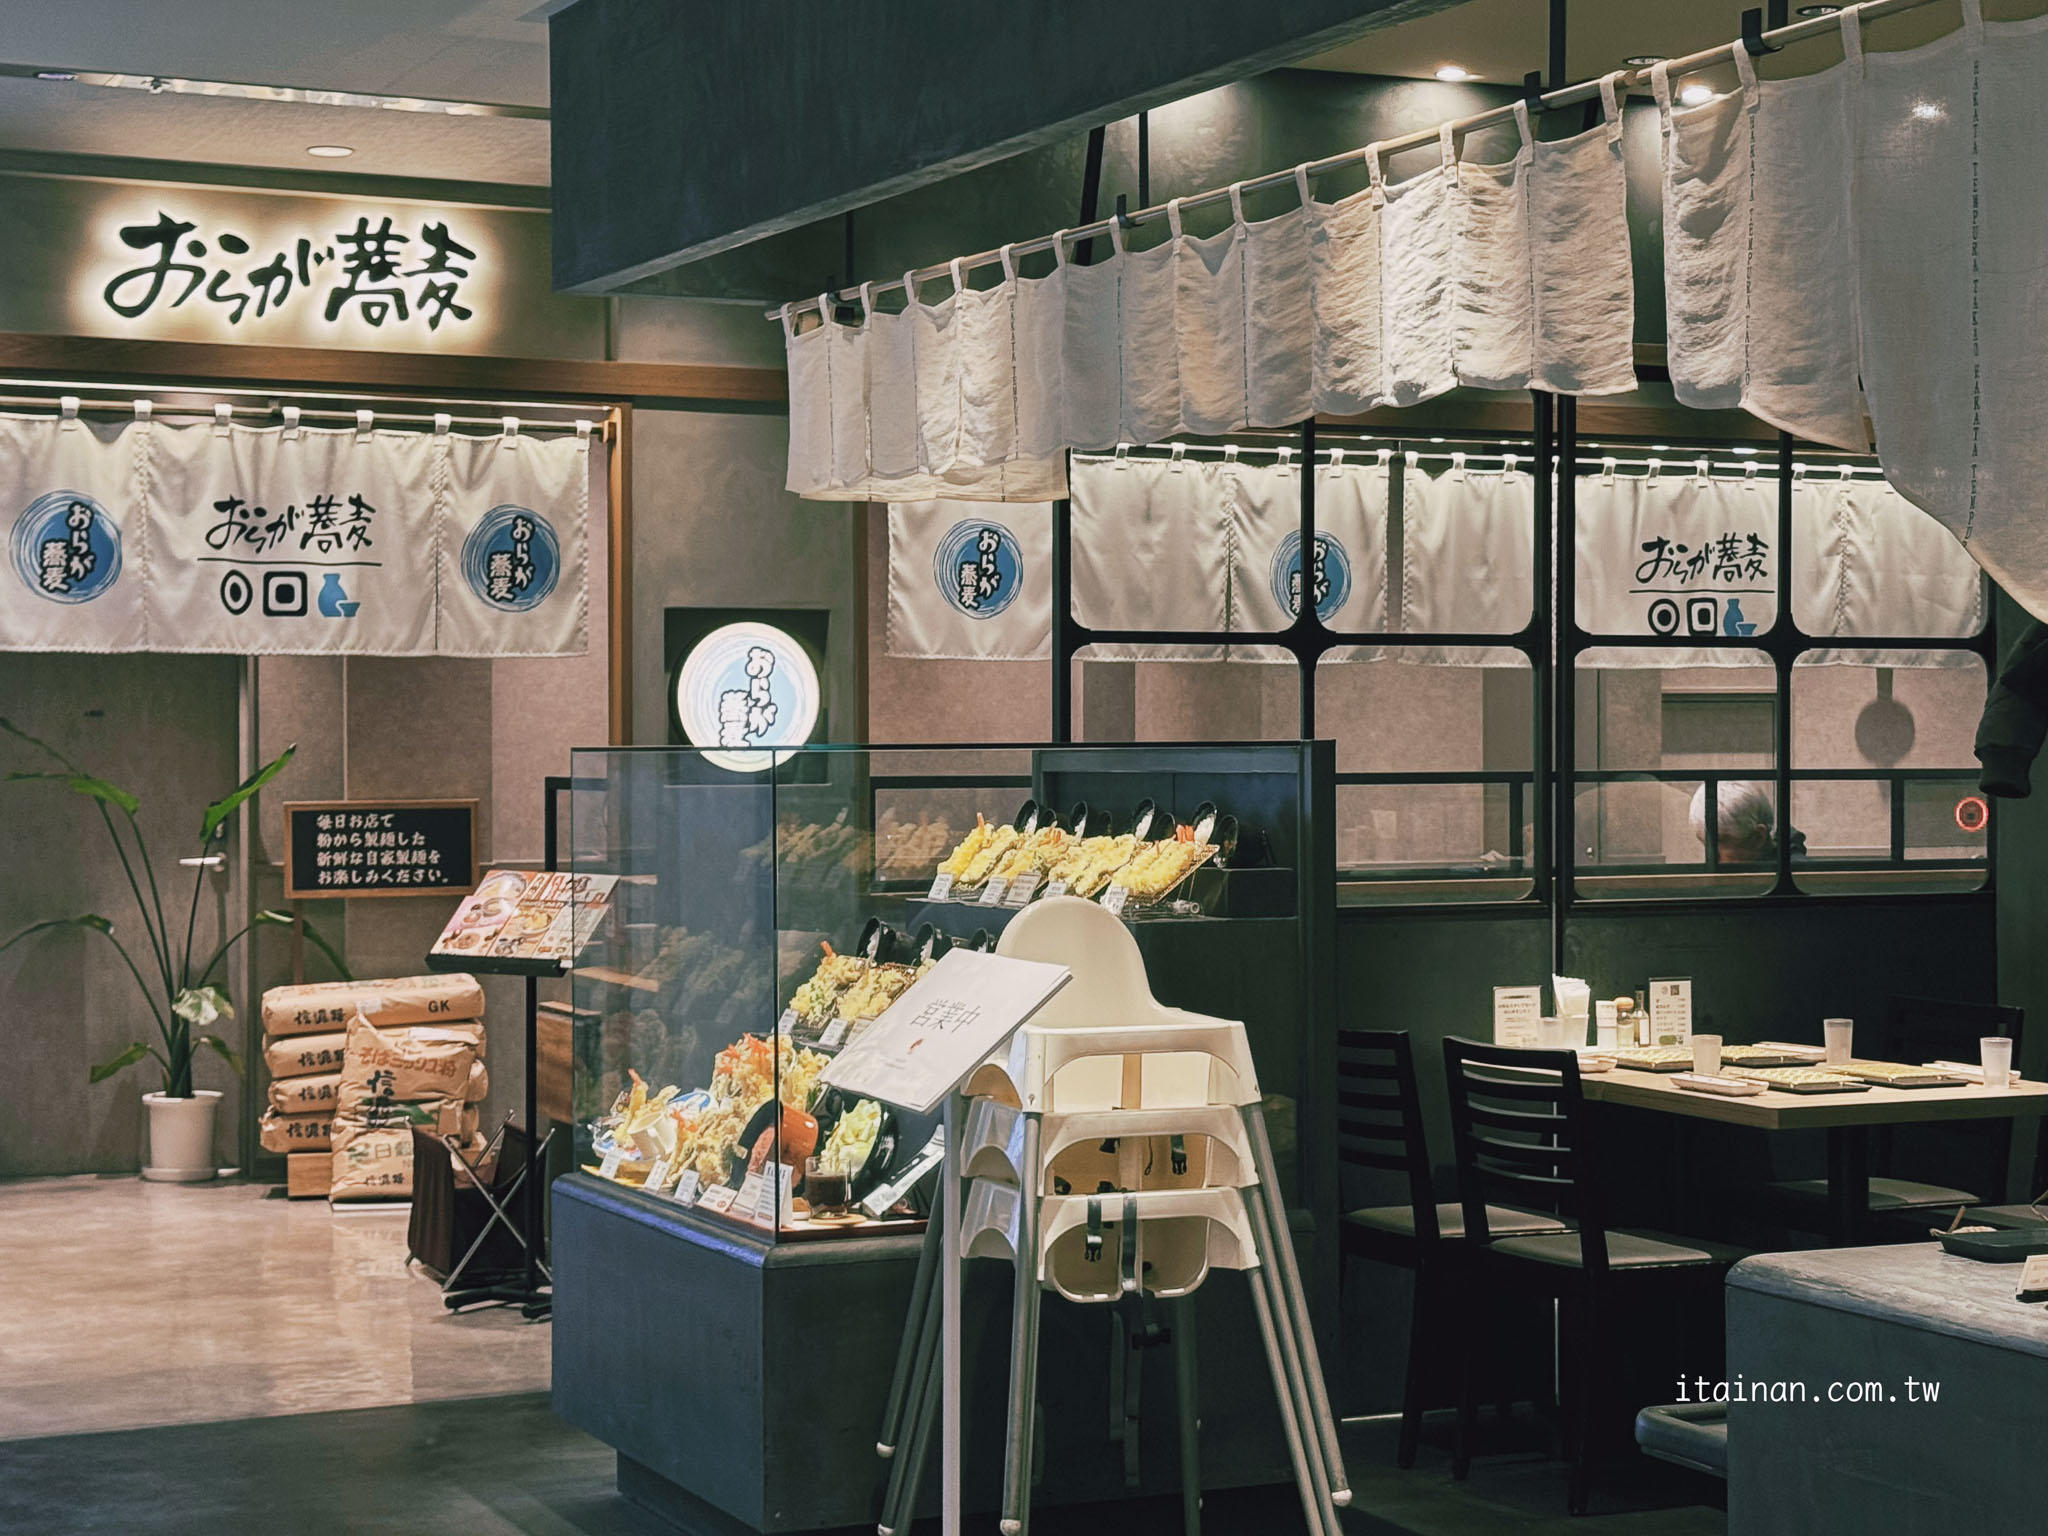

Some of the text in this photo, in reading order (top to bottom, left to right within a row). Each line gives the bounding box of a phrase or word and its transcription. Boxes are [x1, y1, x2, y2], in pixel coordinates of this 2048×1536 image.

[104, 211, 477, 331] おらが蕎麦
[65, 501, 96, 581] おらが
[206, 494, 376, 552] おらが蕎麦
[510, 514, 536, 592] おらが
[40, 538, 71, 593] 蕎麦
[486, 550, 515, 602] 蕎麦
[979, 528, 1001, 600] おらが
[1636, 533, 1769, 584] おらが蕎麦
[745, 646, 778, 738] おらが
[428, 1000, 450, 1013] GK
